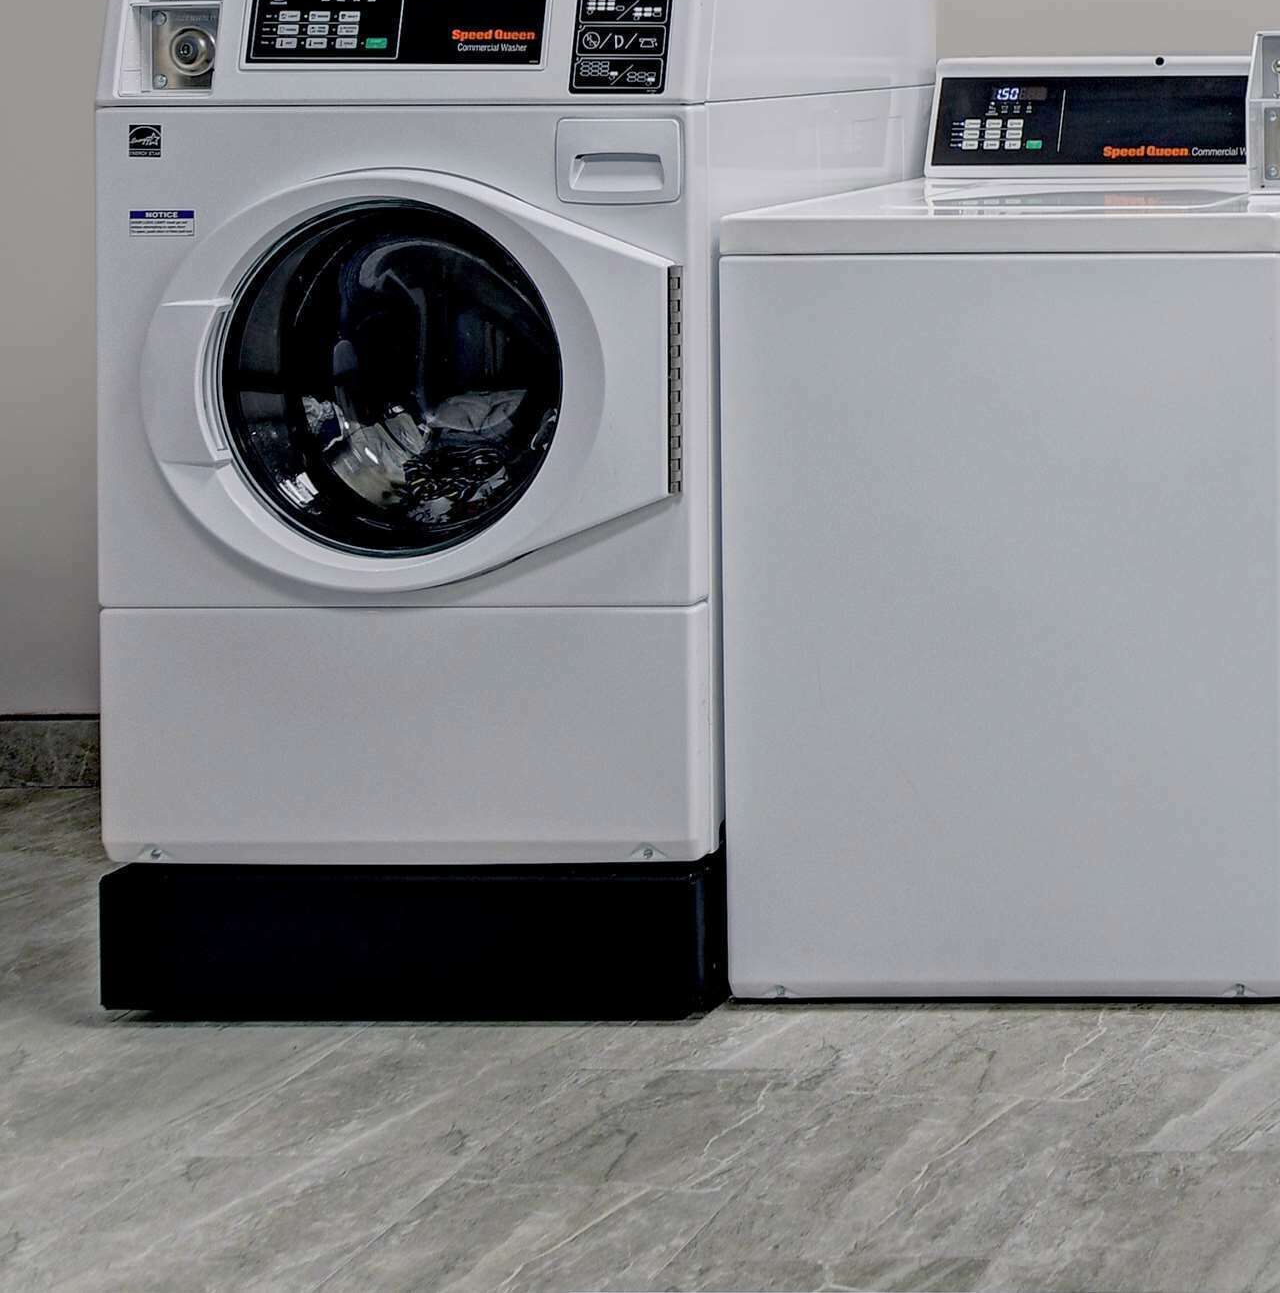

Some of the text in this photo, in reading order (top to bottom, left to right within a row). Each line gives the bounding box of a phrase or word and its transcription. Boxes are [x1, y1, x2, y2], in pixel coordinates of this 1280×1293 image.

[452, 29, 536, 41] Speed Queen
[457, 43, 528, 52] Commercial Washer
[1103, 146, 1146, 158] Speed
[1146, 146, 1189, 156] Queen
[1191, 147, 1238, 156] Commercial
